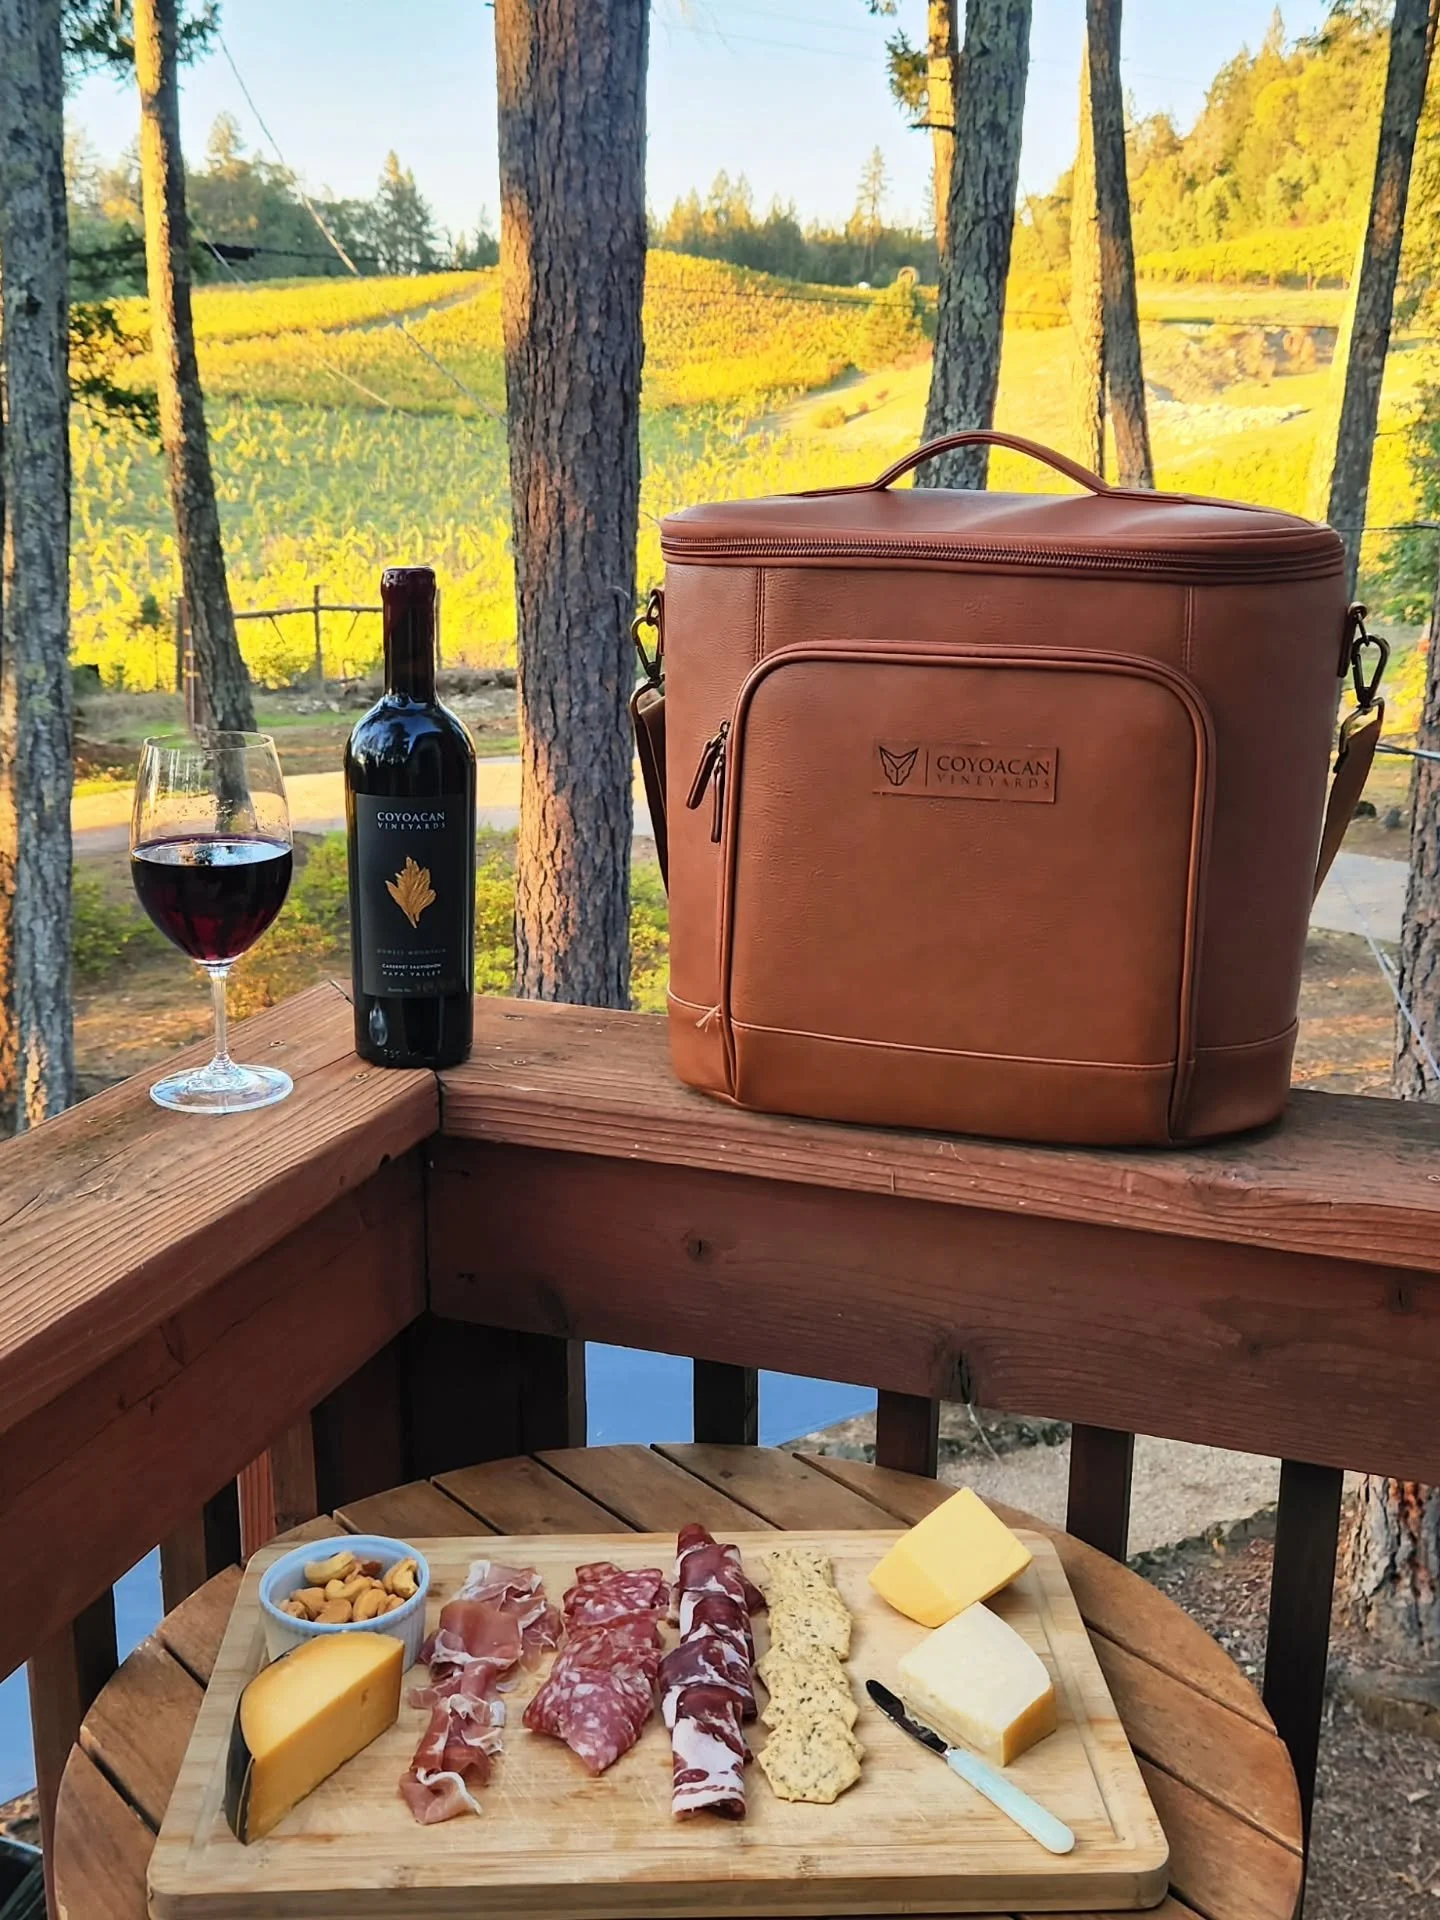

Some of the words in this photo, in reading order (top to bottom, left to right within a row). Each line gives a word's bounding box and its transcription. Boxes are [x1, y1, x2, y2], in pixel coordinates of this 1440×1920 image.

[936, 756, 1050, 776] COYOACAN
[936, 774, 1050, 789] VINEYARDS
[377, 811, 445, 822] COYOACAN
[377, 822, 446, 830] VINEYARDS
